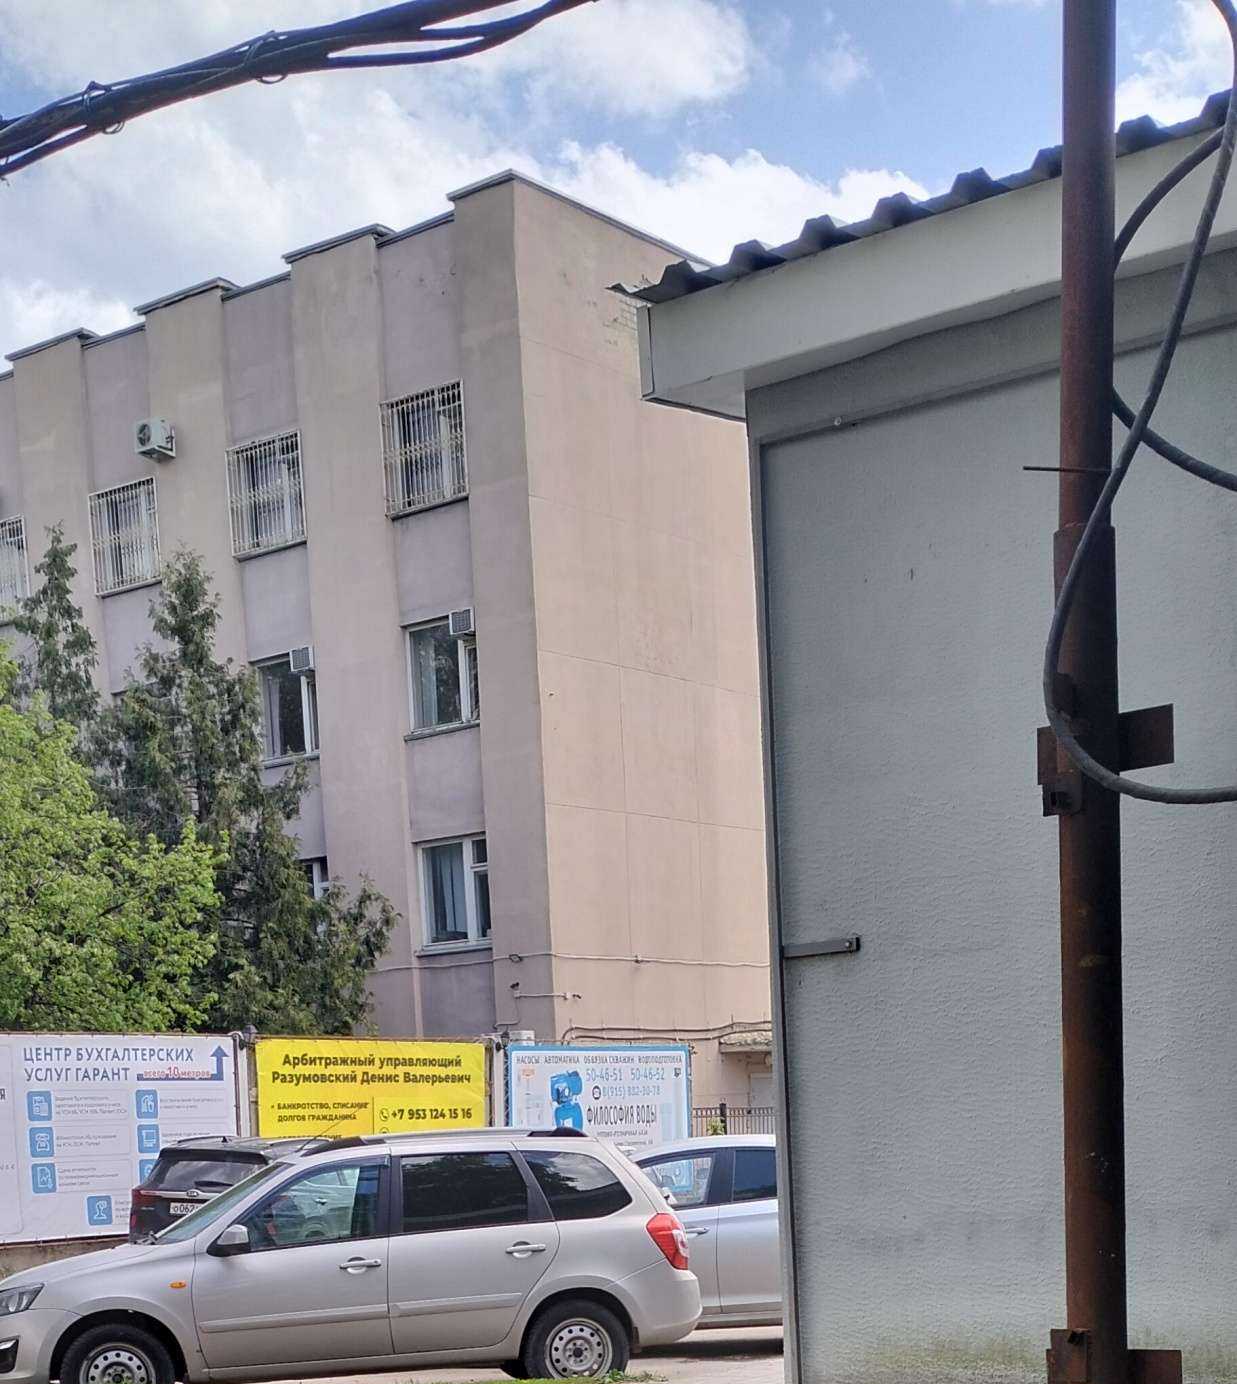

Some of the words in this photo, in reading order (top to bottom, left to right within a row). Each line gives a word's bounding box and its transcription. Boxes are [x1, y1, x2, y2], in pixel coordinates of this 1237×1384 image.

[23, 1047, 71, 1063] ЦЕНТР
[76, 1047, 194, 1062] БУХГАЛТЕРСКИХ
[282, 1053, 375, 1068] Арбитражный
[378, 1055, 462, 1069] управляющий
[25, 1067, 72, 1082] УСЛУГ
[75, 1067, 130, 1081] ГАРАНТ
[271, 1070, 357, 1086] Разумовский
[361, 1072, 399, 1086] Денис
[403, 1071, 470, 1086] Валерьевич
[277, 1102, 331, 1110] БАНКРОТСТВО,
[391, 1108, 405, 1120] +7
[408, 1108, 427, 1120] 953
[430, 1108, 446, 1119] 124
[449, 1108, 459, 1119] 15
[461, 1107, 472, 1119] 16
[277, 1114, 306, 1122] ДОЛГОВ
[586, 1105, 634, 1125] ФИЛОСОФИЯ
[636, 1105, 657, 1127] ВОДЫ
